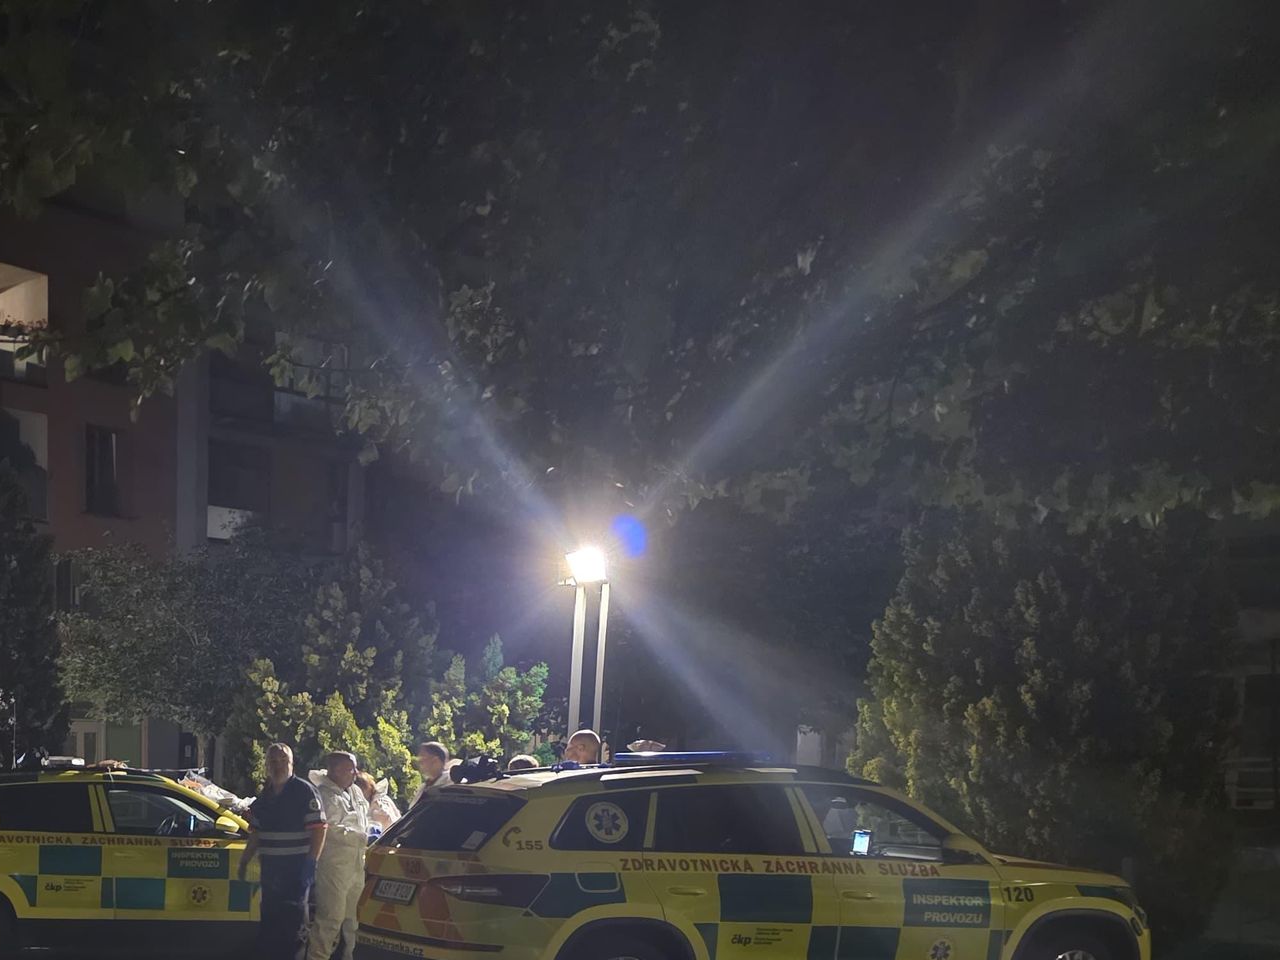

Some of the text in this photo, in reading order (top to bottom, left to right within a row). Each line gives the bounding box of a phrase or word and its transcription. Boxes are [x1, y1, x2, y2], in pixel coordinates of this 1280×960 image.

[516, 840, 543, 850] 155
[913, 893, 984, 906] INSPEKTOR
[1004, 886, 1034, 902] 120
[924, 911, 983, 924] PROVOZU
[730, 933, 752, 947] čkp
